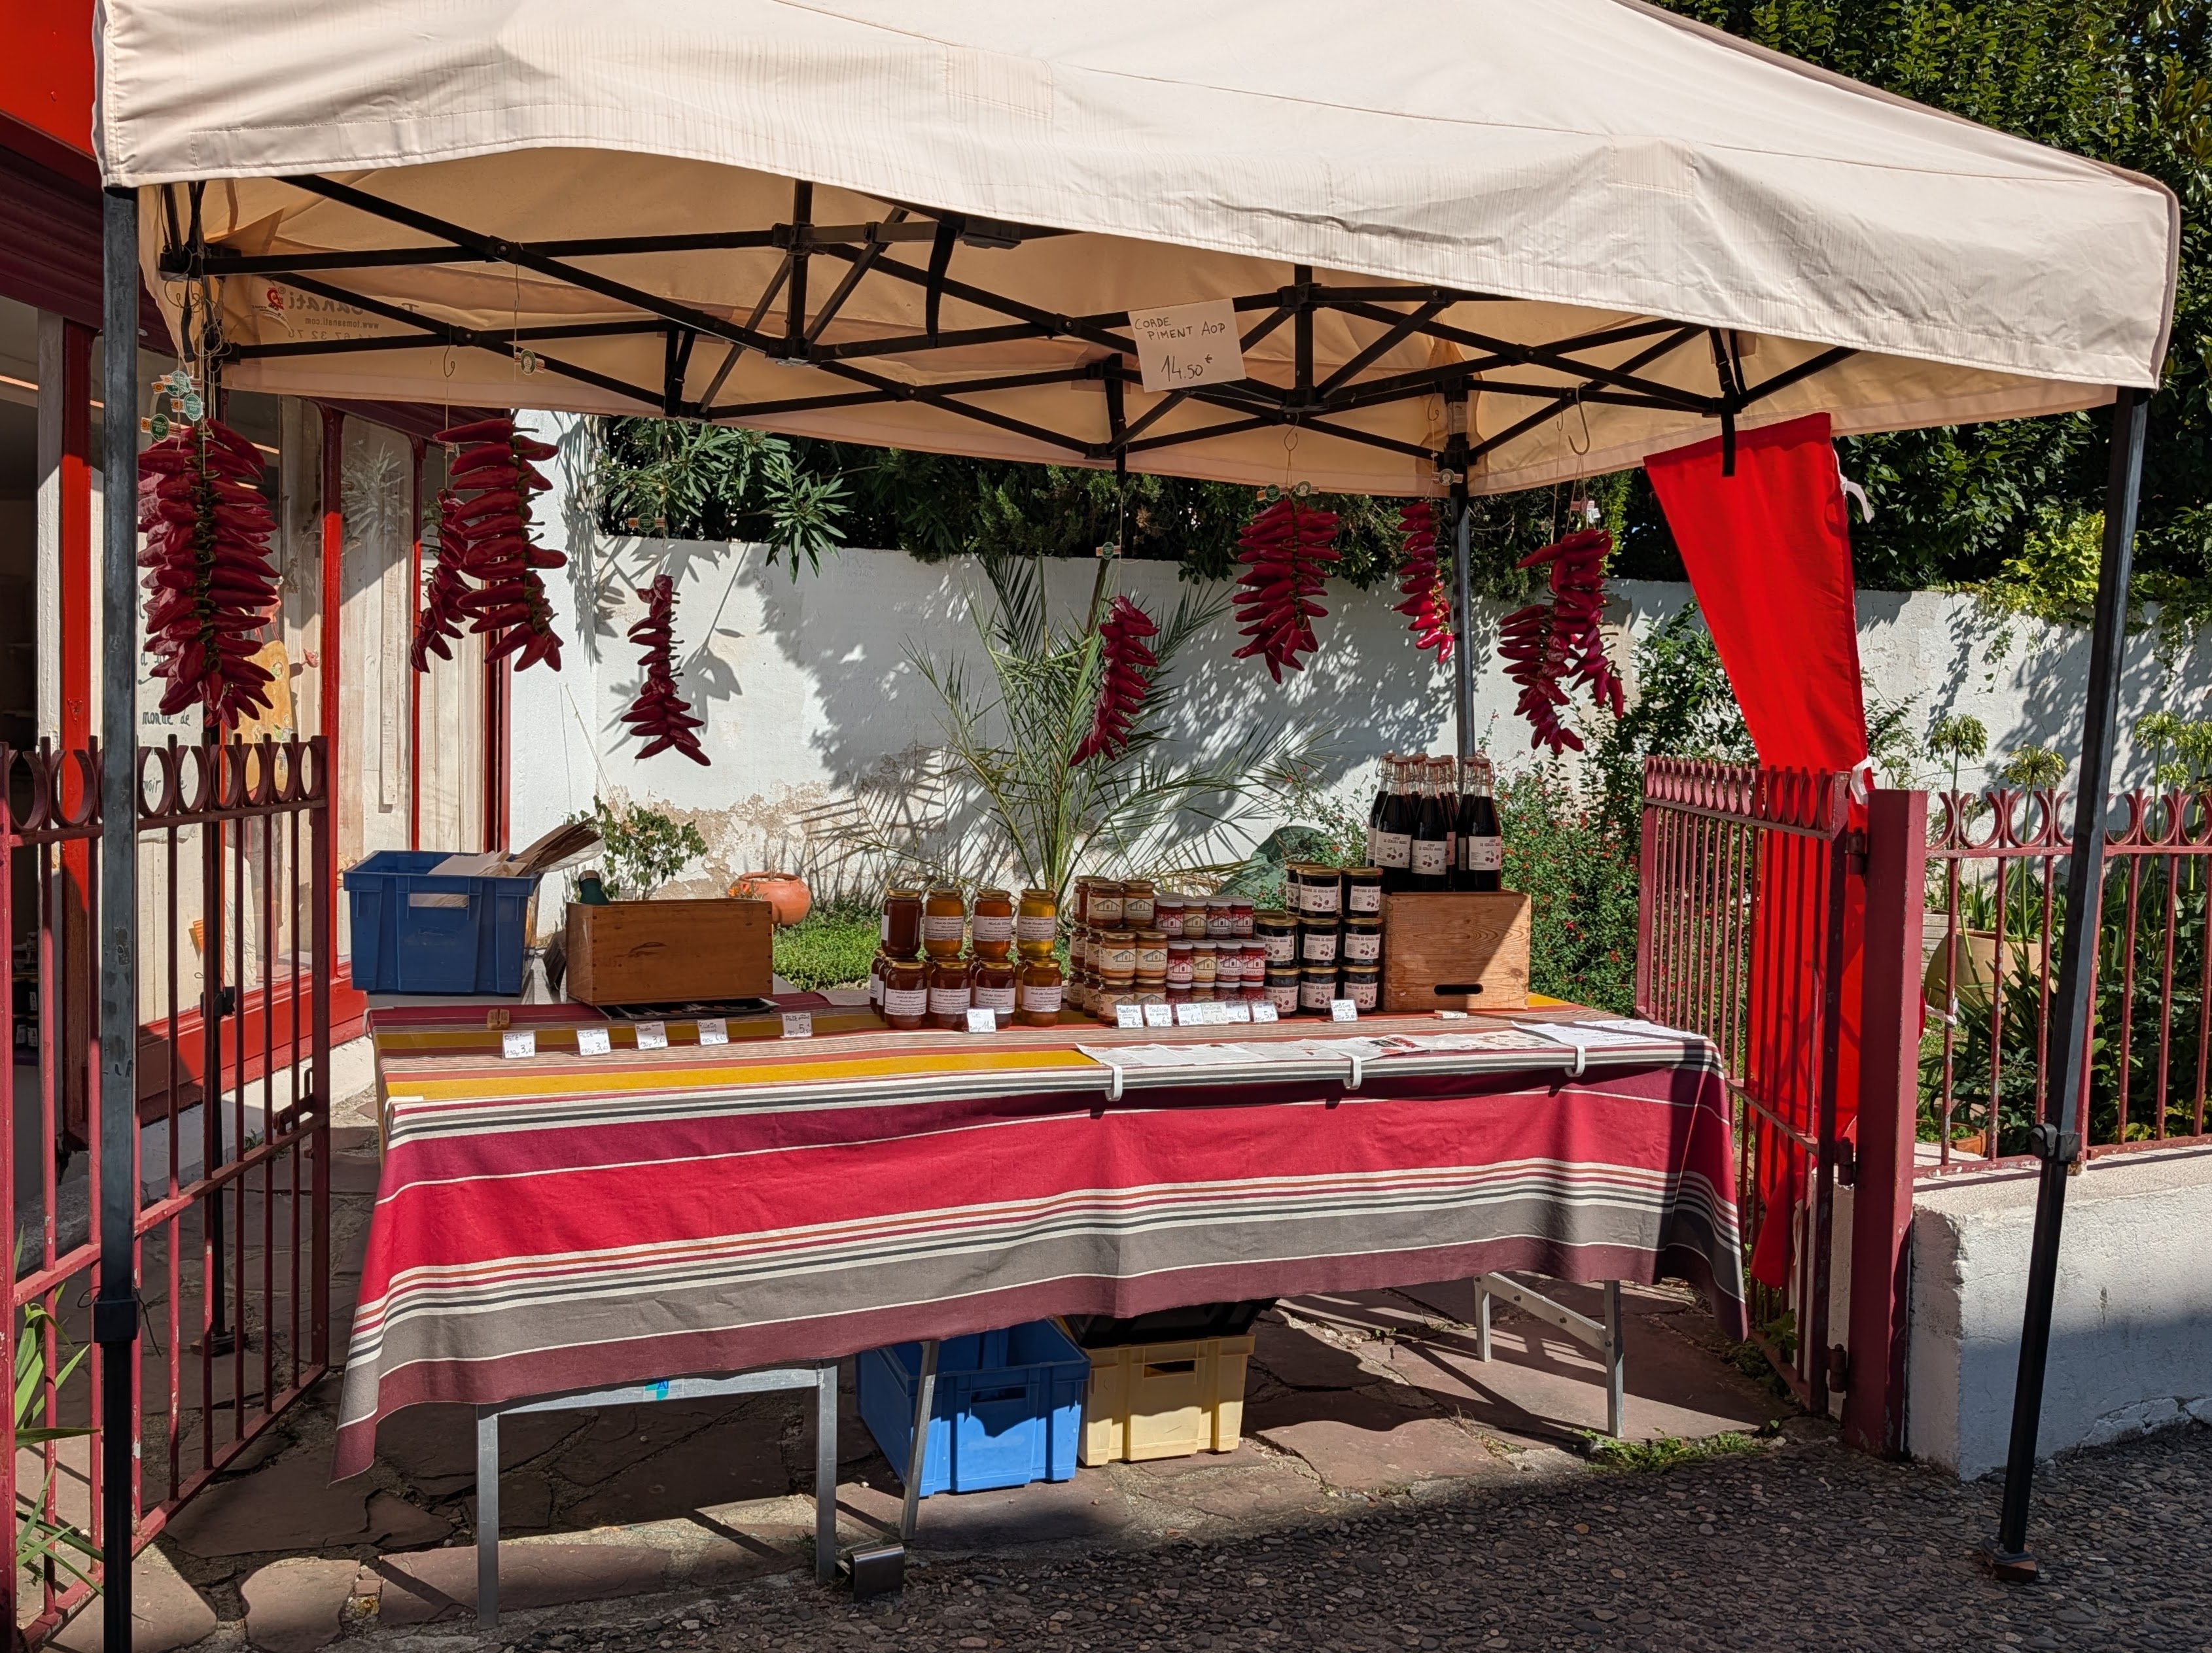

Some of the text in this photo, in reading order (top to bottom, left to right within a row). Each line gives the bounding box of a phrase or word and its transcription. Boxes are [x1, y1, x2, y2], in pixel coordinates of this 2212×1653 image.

[1135, 317, 1171, 330] CORDE
[1147, 321, 1225, 340] PIMENT AOP
